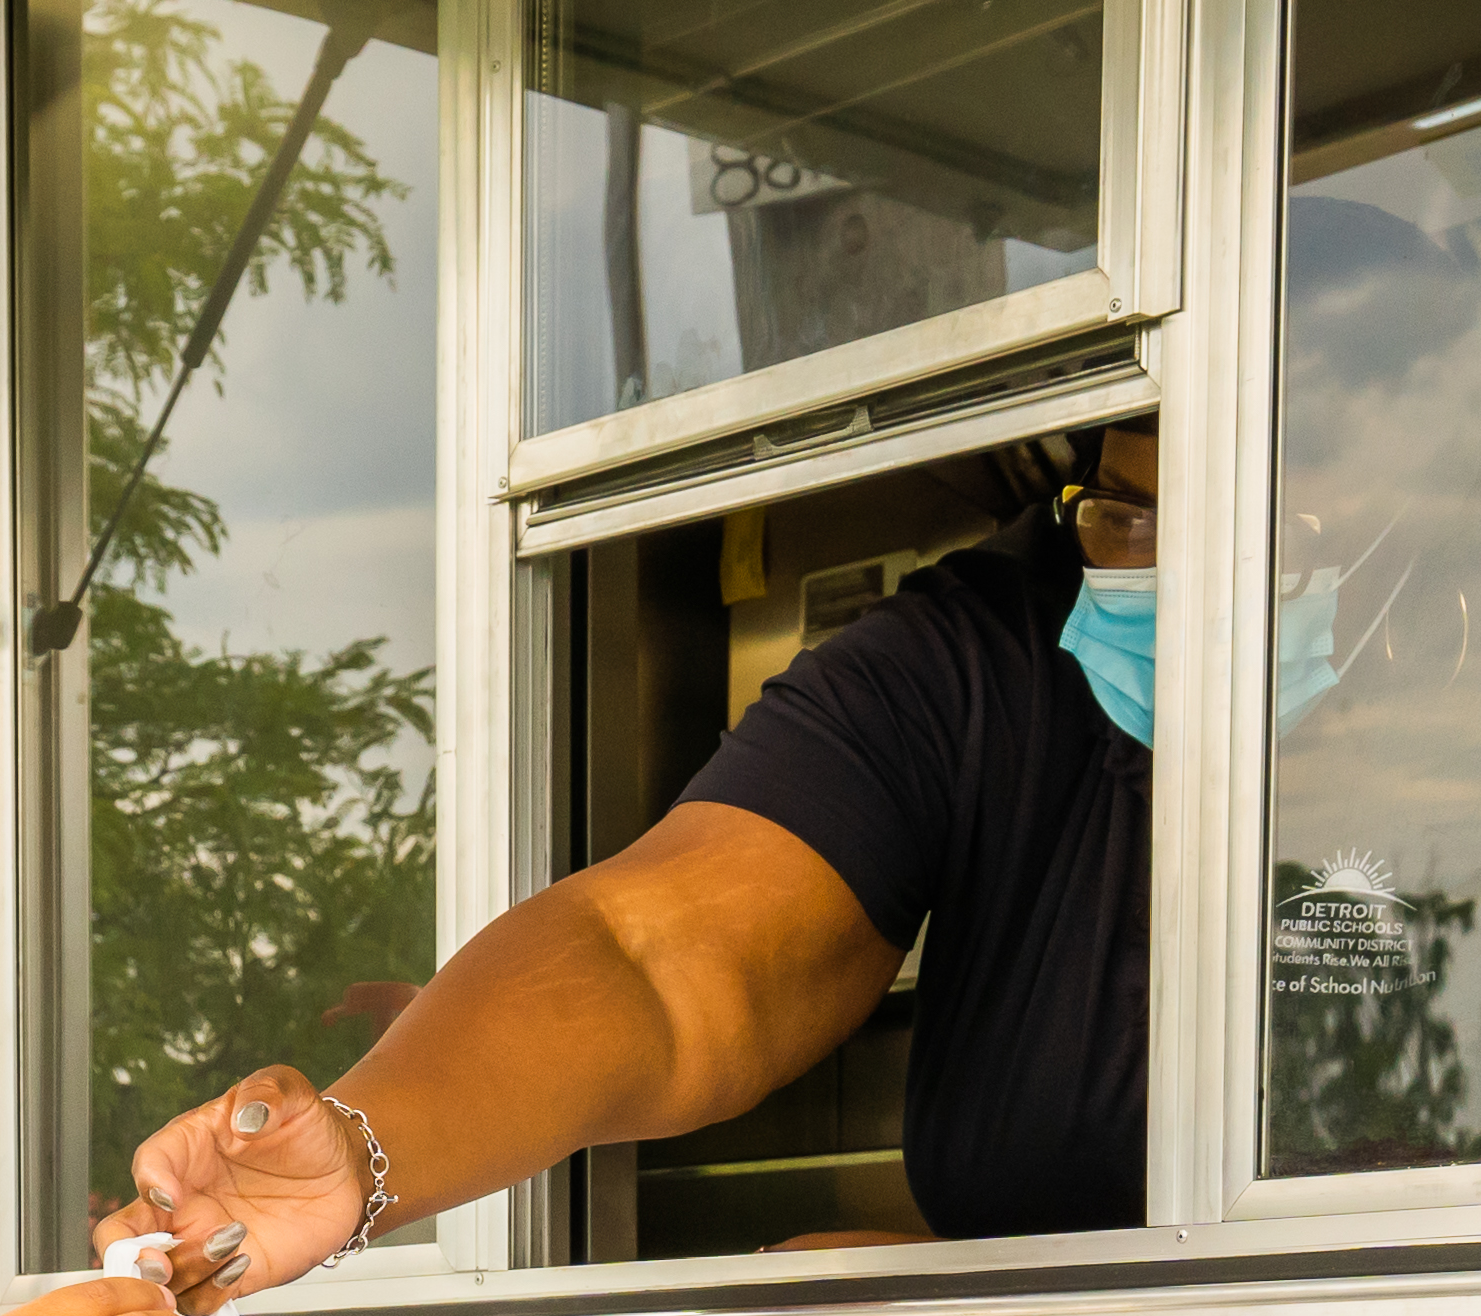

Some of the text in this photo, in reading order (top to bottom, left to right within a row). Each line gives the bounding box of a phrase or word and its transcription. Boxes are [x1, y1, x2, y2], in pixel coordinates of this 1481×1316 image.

[1301, 902, 1386, 919] DETROIT
[1281, 919, 1403, 935] PUBLIC SCHOOLS
[1275, 936, 1412, 952] COMMUNITY DISTRICT
[1350, 955, 1369, 967] We
[1373, 955, 1389, 967] All
[1289, 975, 1307, 992] of
[1310, 976, 1366, 994] School
[1371, 970, 1436, 994] Nutrition
